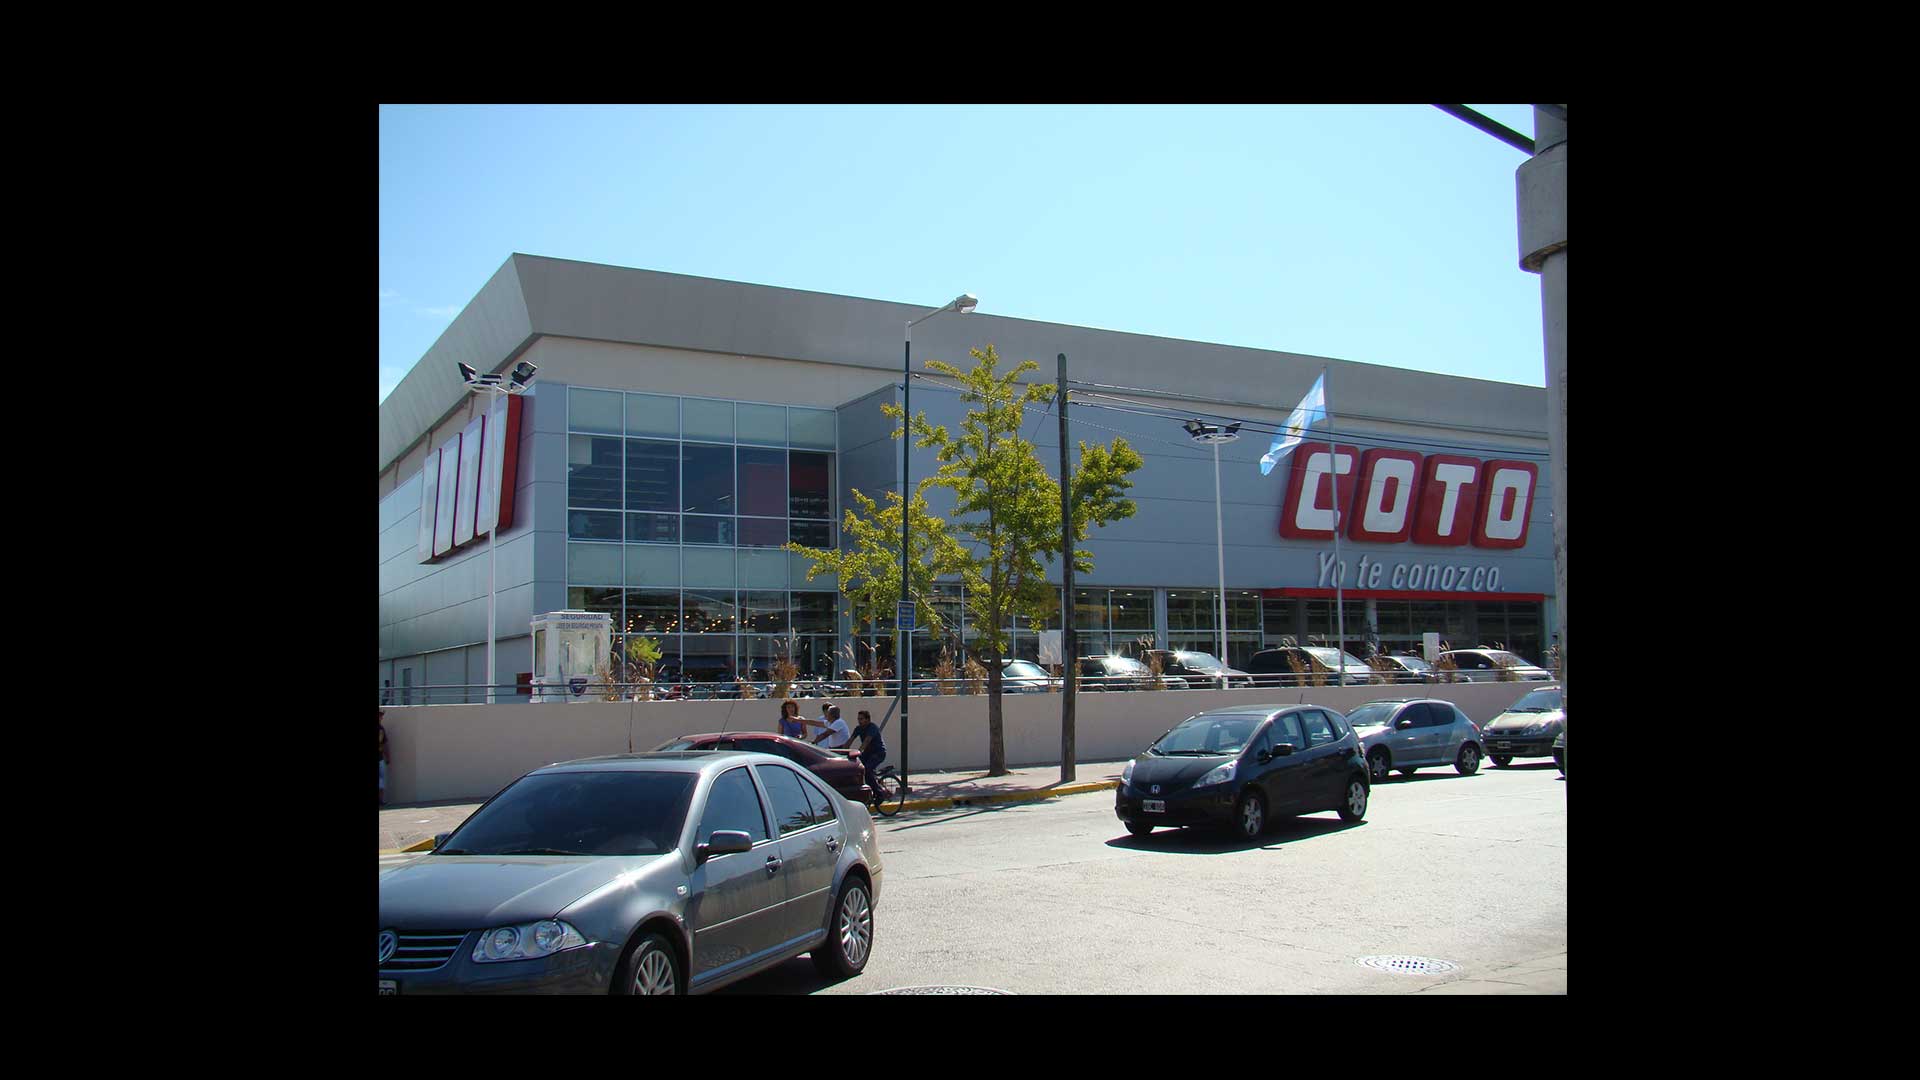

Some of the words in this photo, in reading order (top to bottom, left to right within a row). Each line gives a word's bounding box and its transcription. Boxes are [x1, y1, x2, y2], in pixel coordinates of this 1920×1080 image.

[1295, 452, 1532, 541] COTO
[1318, 551, 1346, 588] Yo
[1357, 554, 1382, 589] te
[1391, 562, 1505, 592] conozco.
